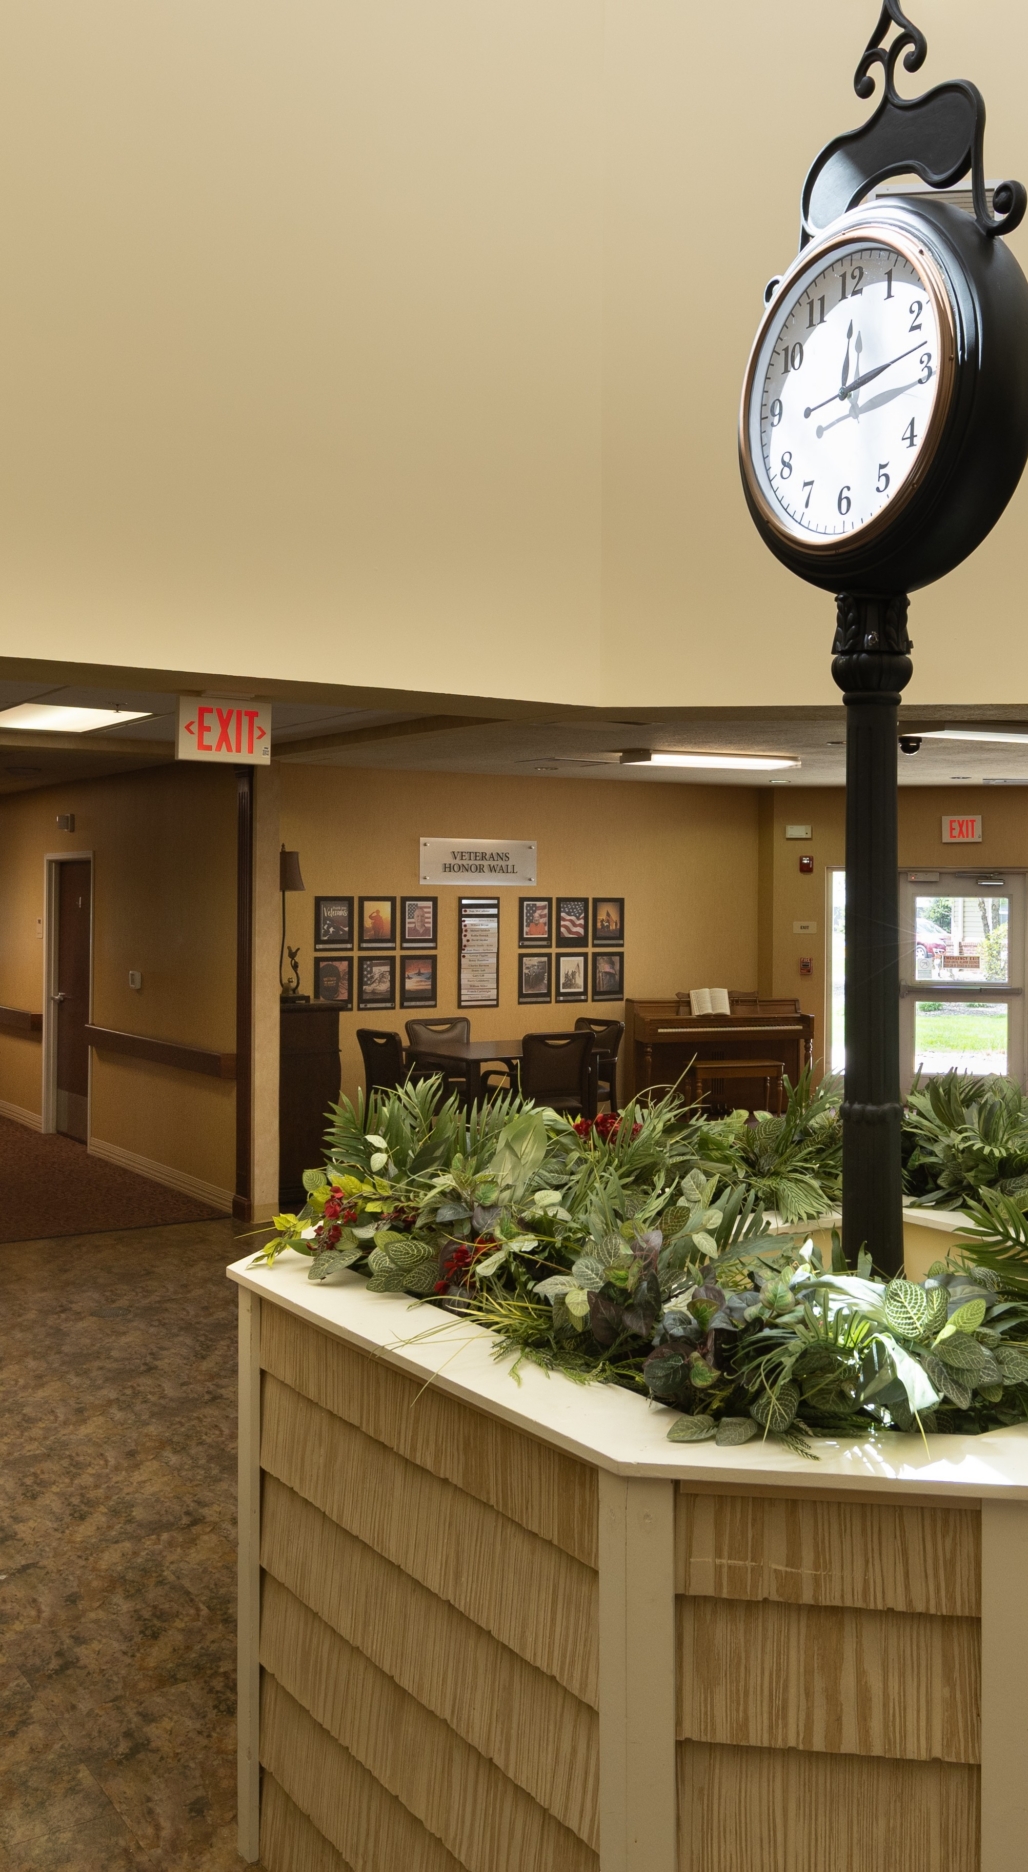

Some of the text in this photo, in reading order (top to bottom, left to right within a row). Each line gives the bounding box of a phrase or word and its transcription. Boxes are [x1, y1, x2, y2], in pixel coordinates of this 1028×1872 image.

[838, 265, 864, 302] 12
[883, 268, 895, 301] 1
[806, 294, 827, 329] 11
[908, 300, 923, 333] 2
[781, 342, 804, 375] 10
[917, 352, 933, 385] 3
[769, 398, 783, 428] 9
[901, 416, 918, 449] 4
[780, 451, 793, 480] 8
[875, 461, 890, 493] 5
[802, 480, 815, 509] 7
[837, 485, 851, 516] 6
[197, 706, 259, 755] EXIT
[949, 818, 976, 839] EXIT
[442, 863, 518, 874] HONOR WALL
[450, 851, 510, 862] VETERANS
